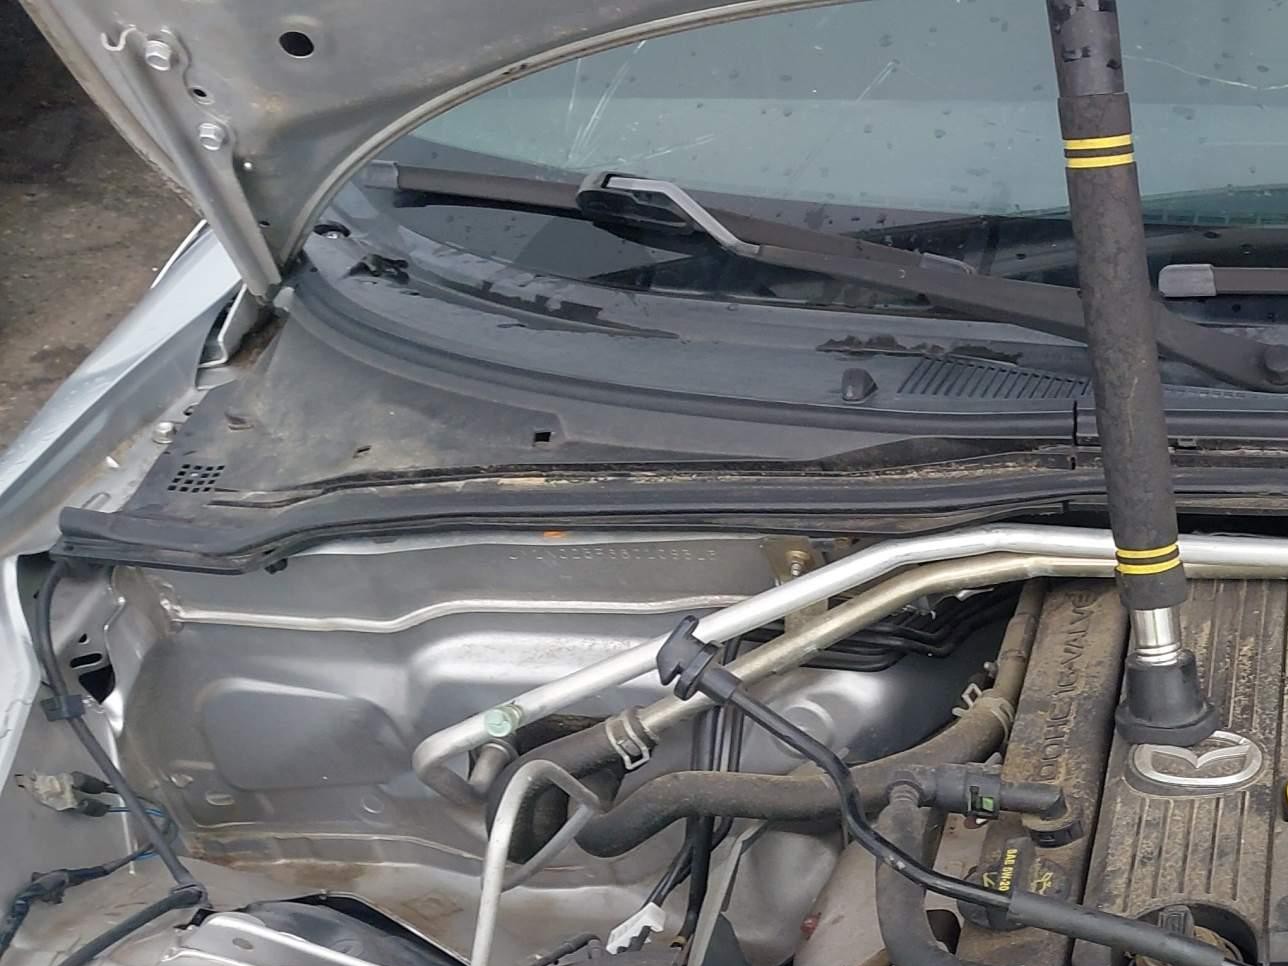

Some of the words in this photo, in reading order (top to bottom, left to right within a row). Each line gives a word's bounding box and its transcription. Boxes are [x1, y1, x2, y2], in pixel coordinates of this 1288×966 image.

[1027, 701, 1073, 782] DOHC
[1054, 594, 1096, 696] 16-VALVE
[1004, 848, 1018, 865] SAE
[998, 866, 1014, 892] 5W-20
